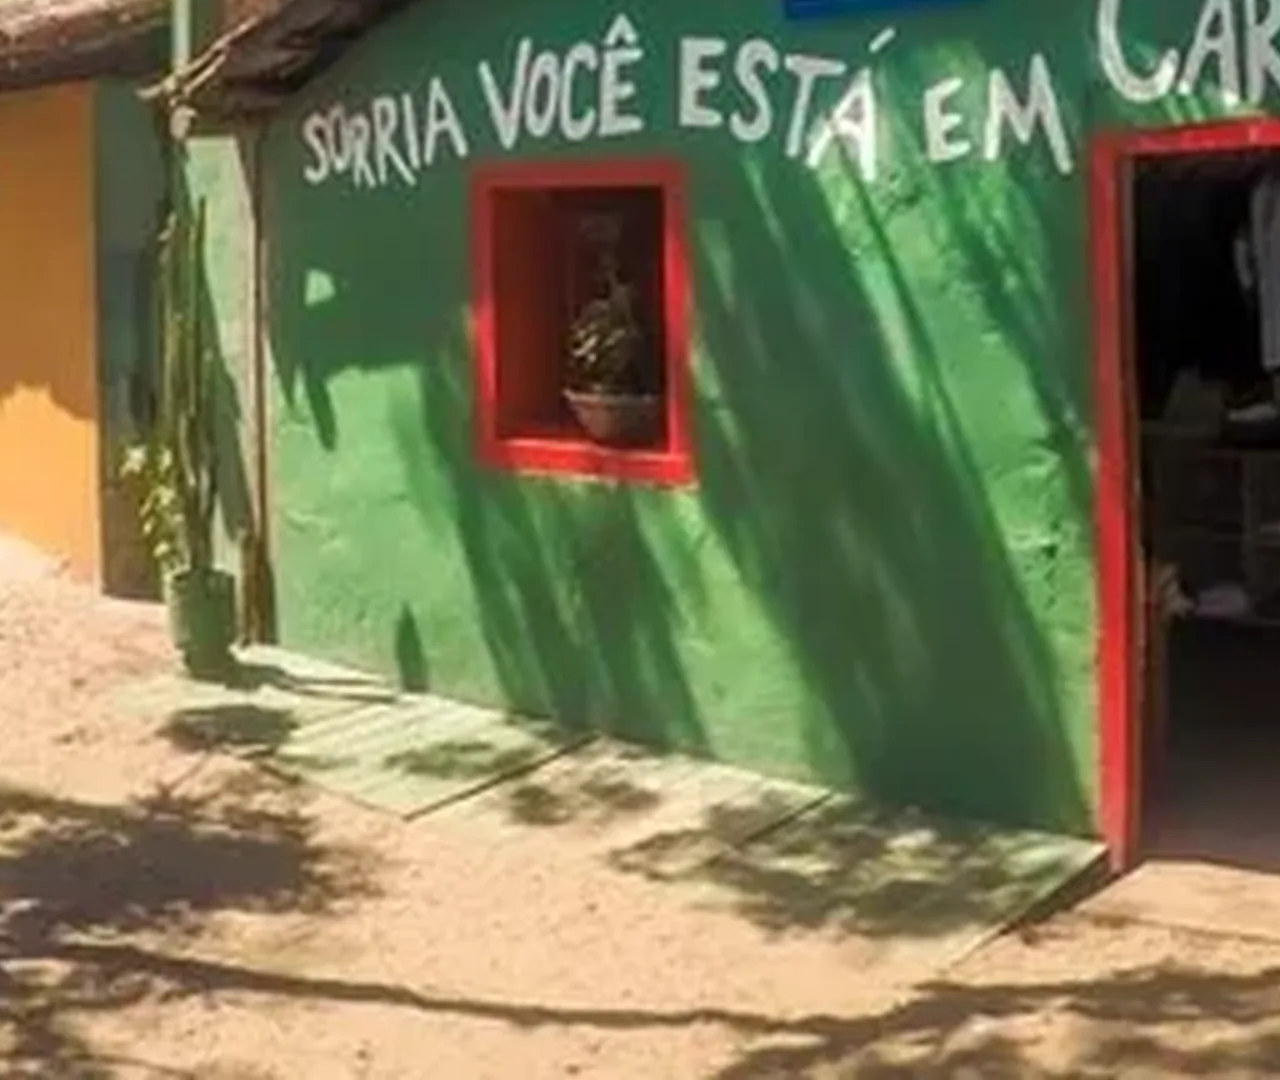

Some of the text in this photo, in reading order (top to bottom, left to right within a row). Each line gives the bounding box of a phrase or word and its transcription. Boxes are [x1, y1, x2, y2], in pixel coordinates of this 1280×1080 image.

[302, 75, 468, 189] SORRIA
[478, 13, 645, 150] VOCÊ
[678, 27, 897, 183] ESTÁ
[924, 52, 1074, 175] EM
